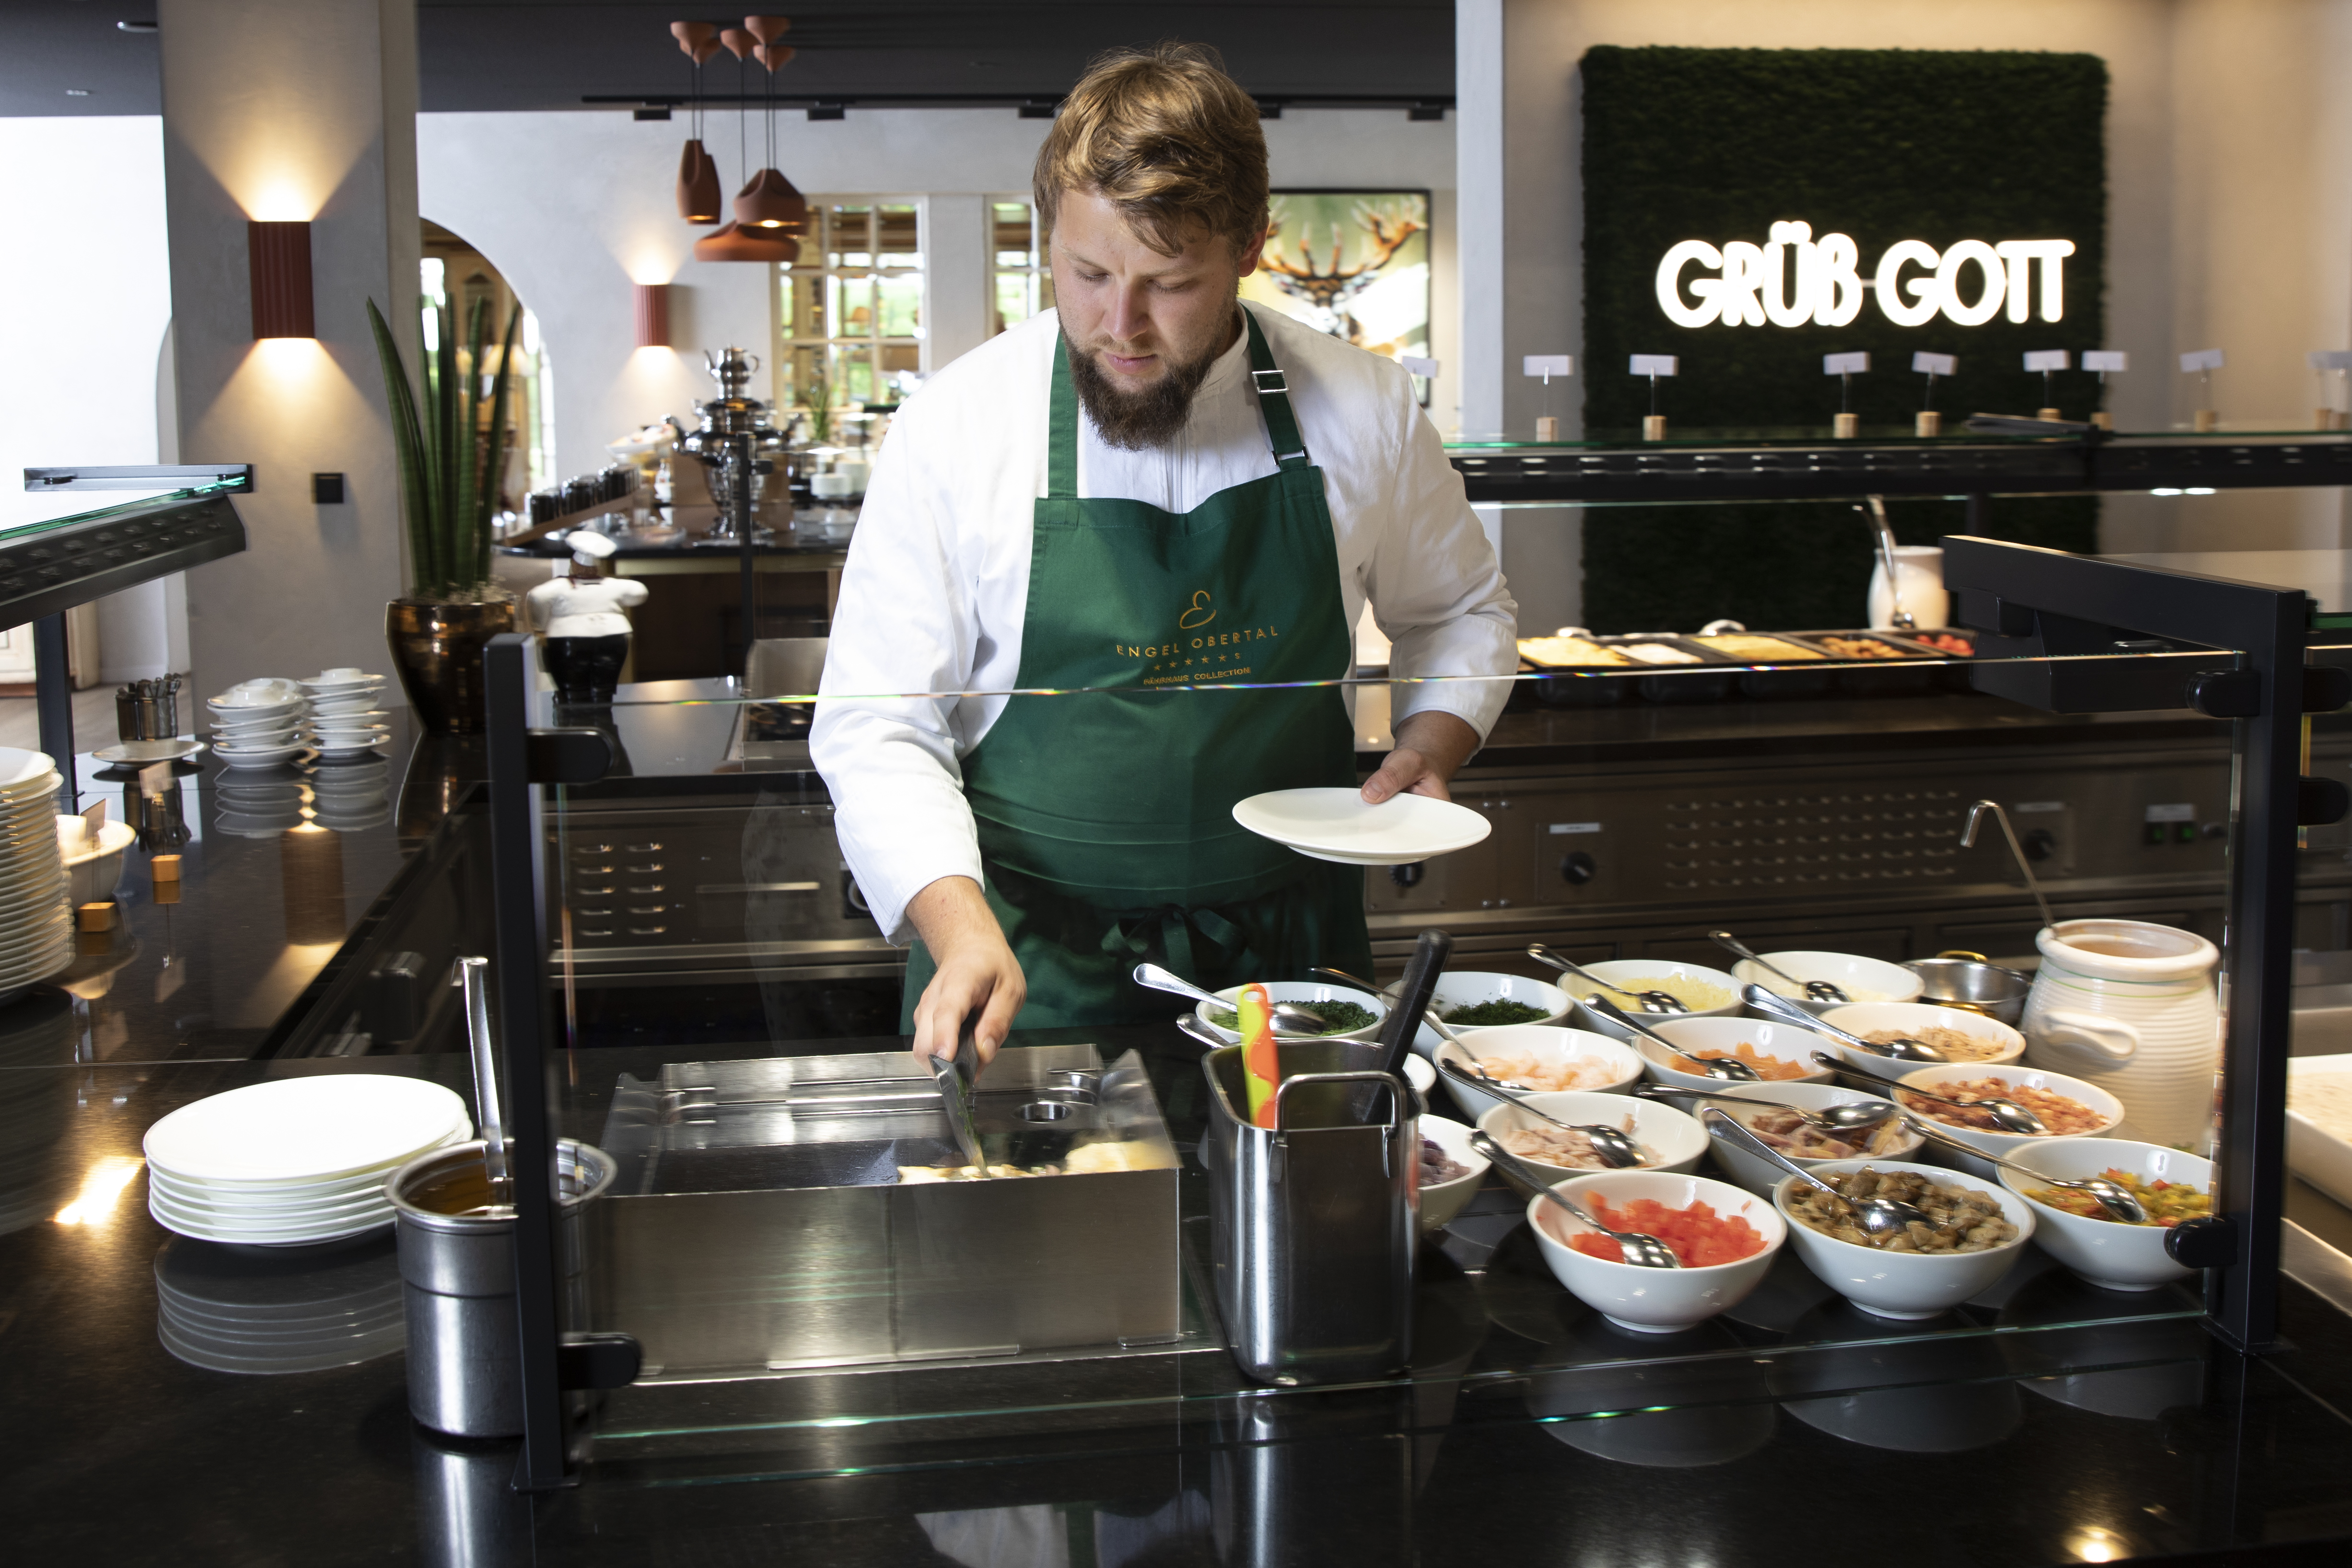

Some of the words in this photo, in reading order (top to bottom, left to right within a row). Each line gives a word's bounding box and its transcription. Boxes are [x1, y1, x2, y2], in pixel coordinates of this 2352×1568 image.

[1875, 239, 2076, 326] GOTT
[1116, 643, 1179, 657] ENGEL
[1191, 626, 1278, 648] OBERTAL
[1194, 667, 1251, 680] COLLECTION
